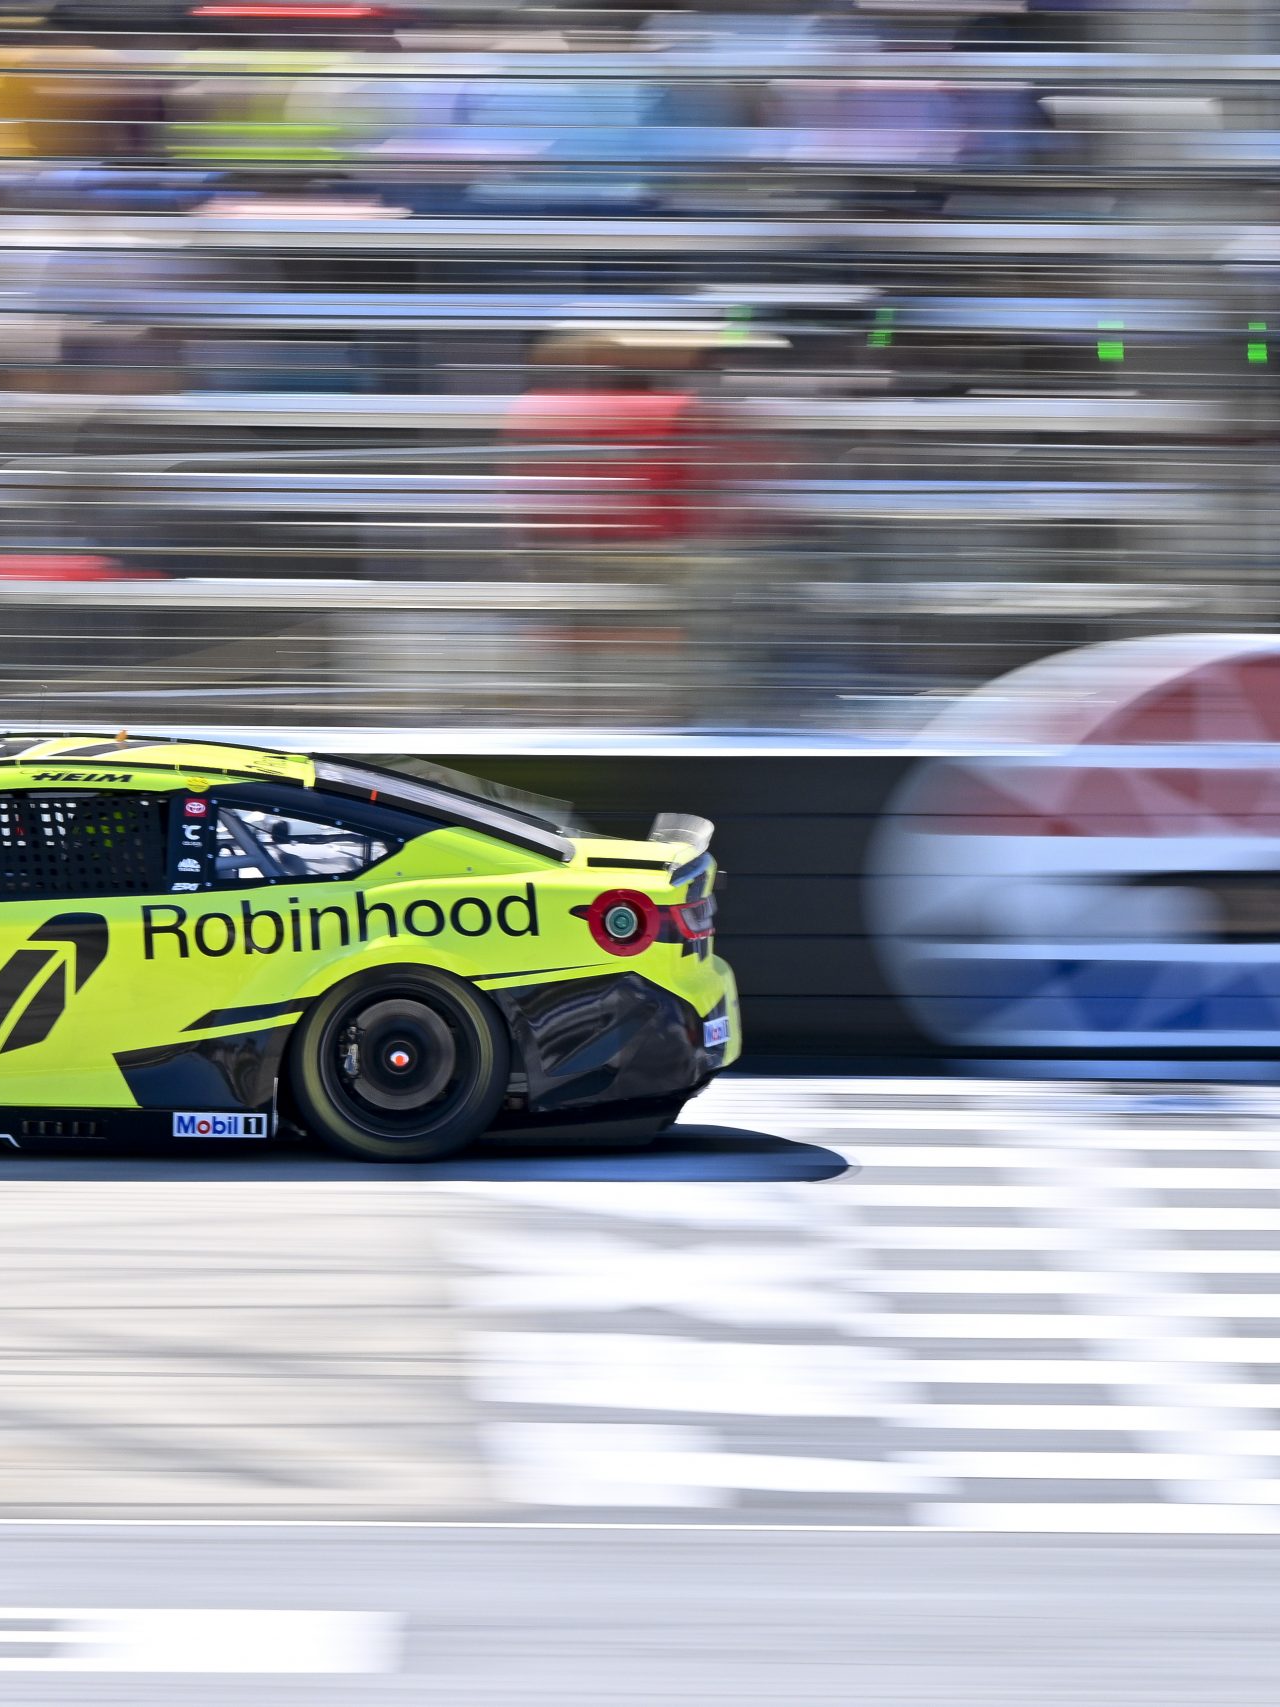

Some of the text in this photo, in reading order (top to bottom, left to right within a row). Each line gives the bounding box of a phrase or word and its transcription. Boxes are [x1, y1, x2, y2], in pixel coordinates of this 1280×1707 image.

[31, 772, 133, 783] HEIM
[142, 882, 540, 960] Robinhood
[177, 1115, 258, 1135] Mobil 1
